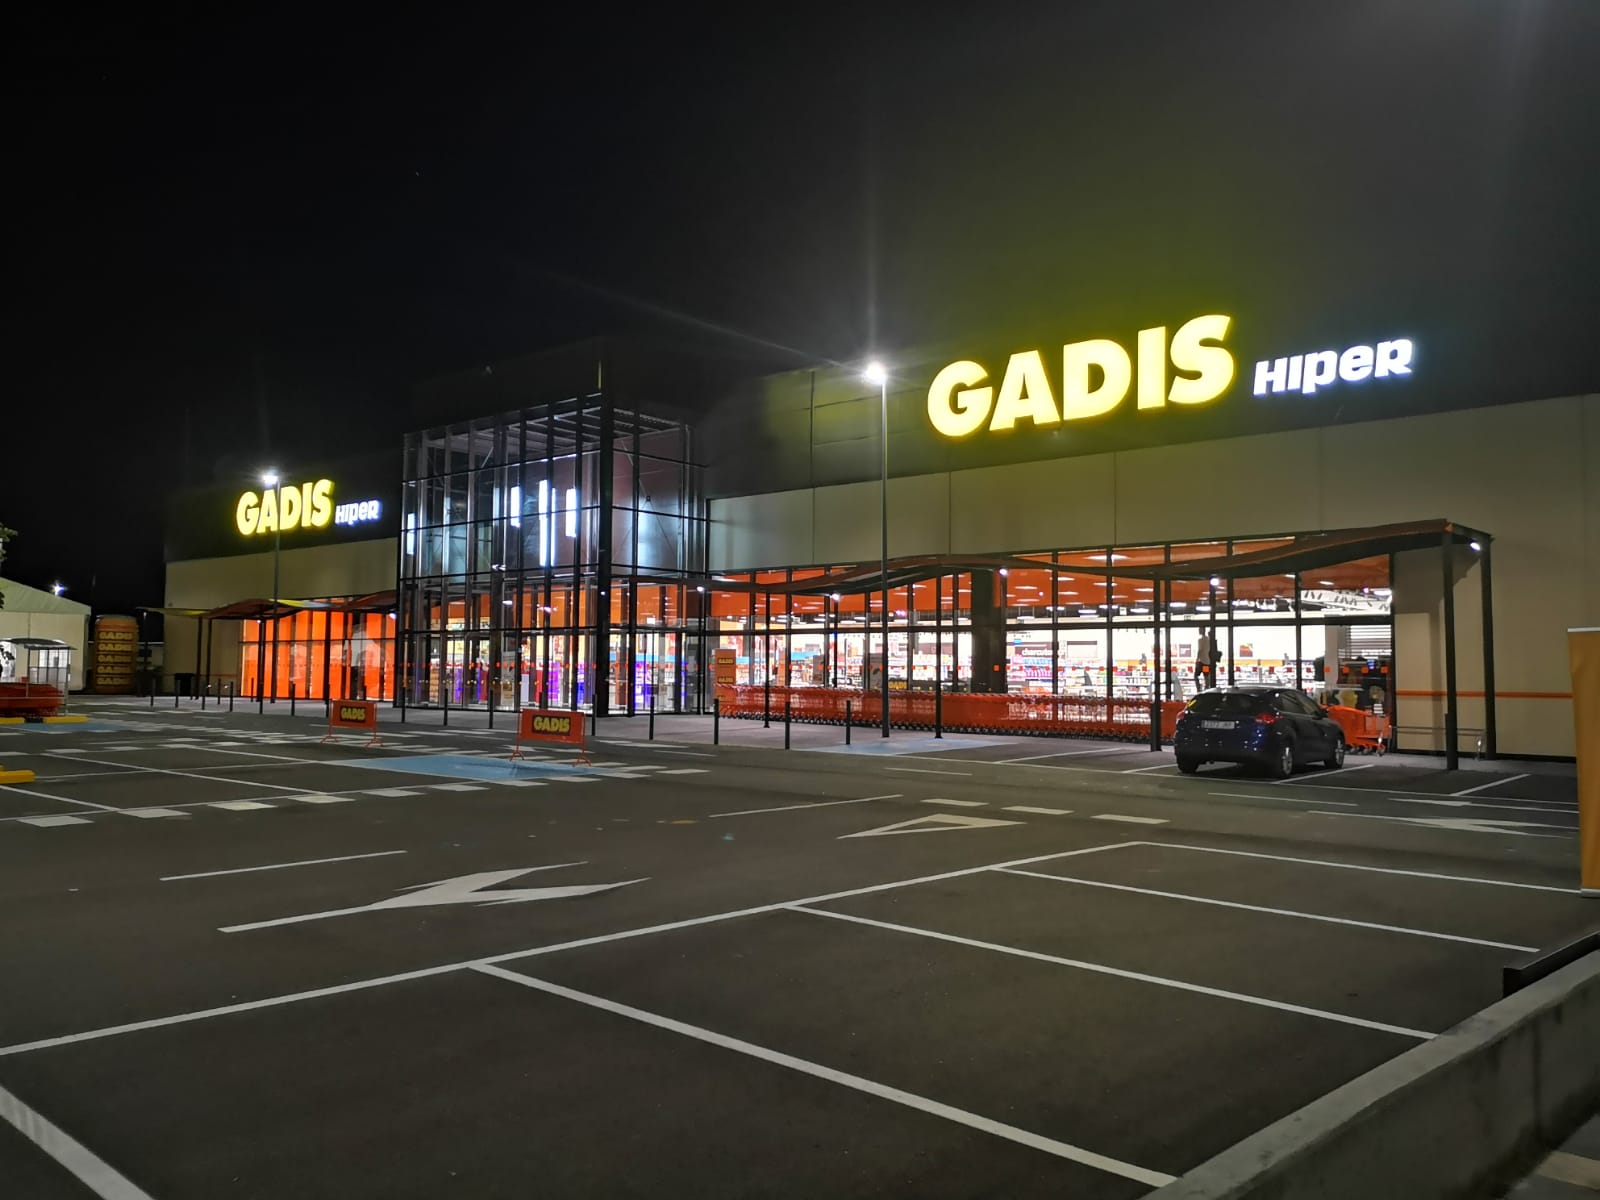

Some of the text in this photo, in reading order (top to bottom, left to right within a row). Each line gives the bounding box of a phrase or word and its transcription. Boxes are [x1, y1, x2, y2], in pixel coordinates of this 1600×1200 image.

[927, 314, 1235, 437] GADIS
[236, 479, 334, 535] GADIS
[341, 707, 366, 721] GADIS
[533, 716, 570, 733] GADIS
